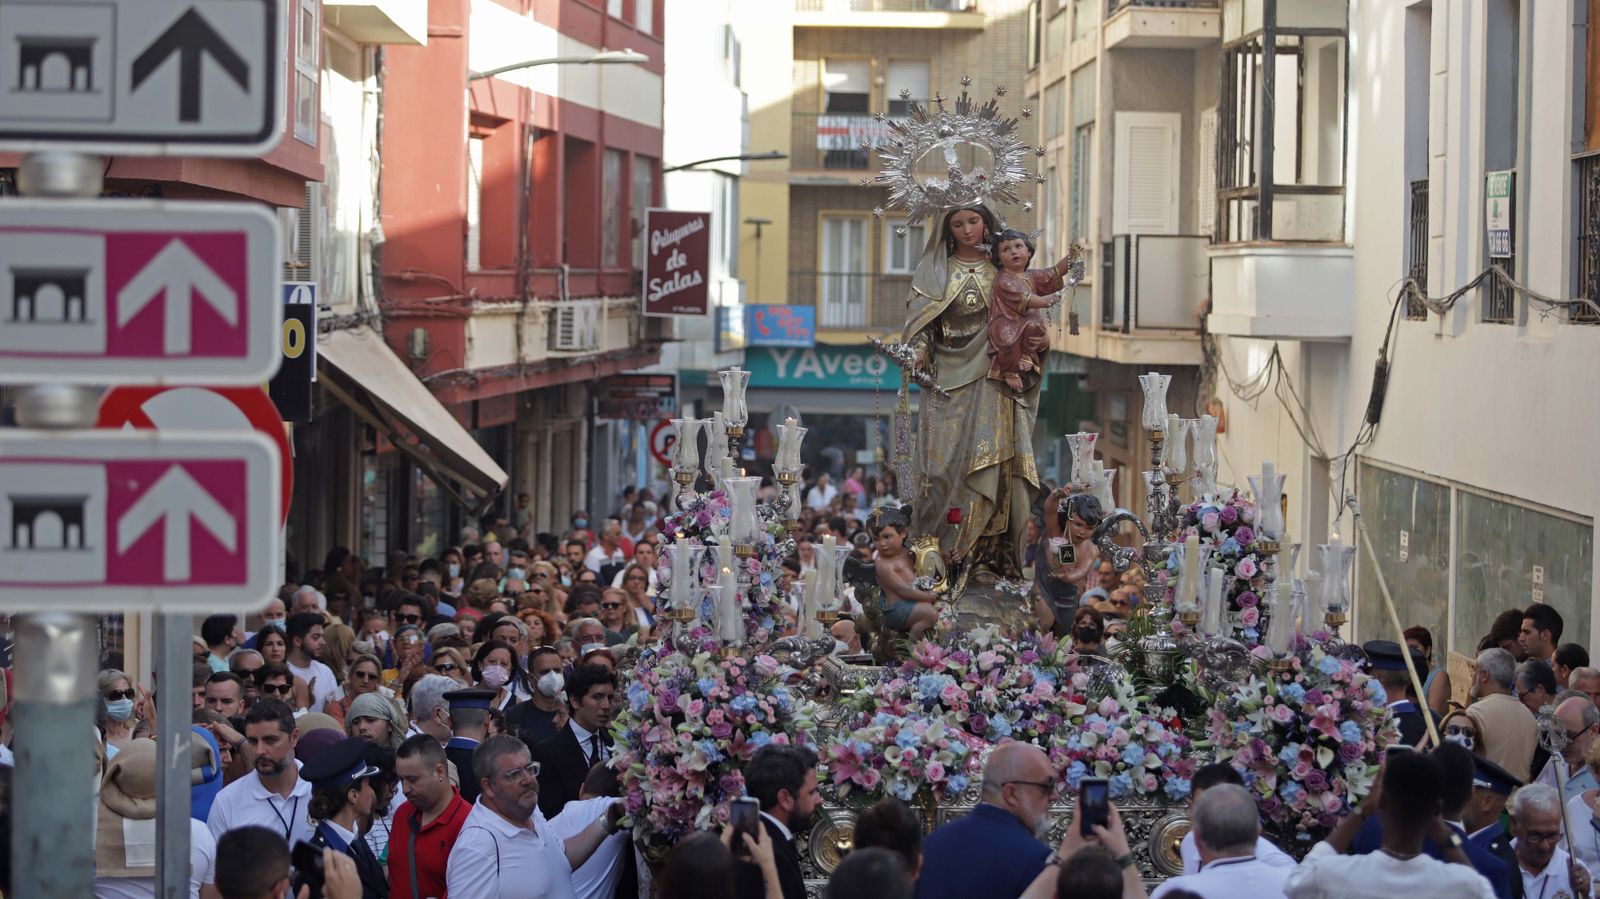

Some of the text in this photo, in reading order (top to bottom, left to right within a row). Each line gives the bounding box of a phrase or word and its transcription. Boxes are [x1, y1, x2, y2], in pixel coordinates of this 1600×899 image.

[665, 248, 688, 272] de
[648, 270, 703, 302] Salas
[768, 348, 888, 379] YAveo
